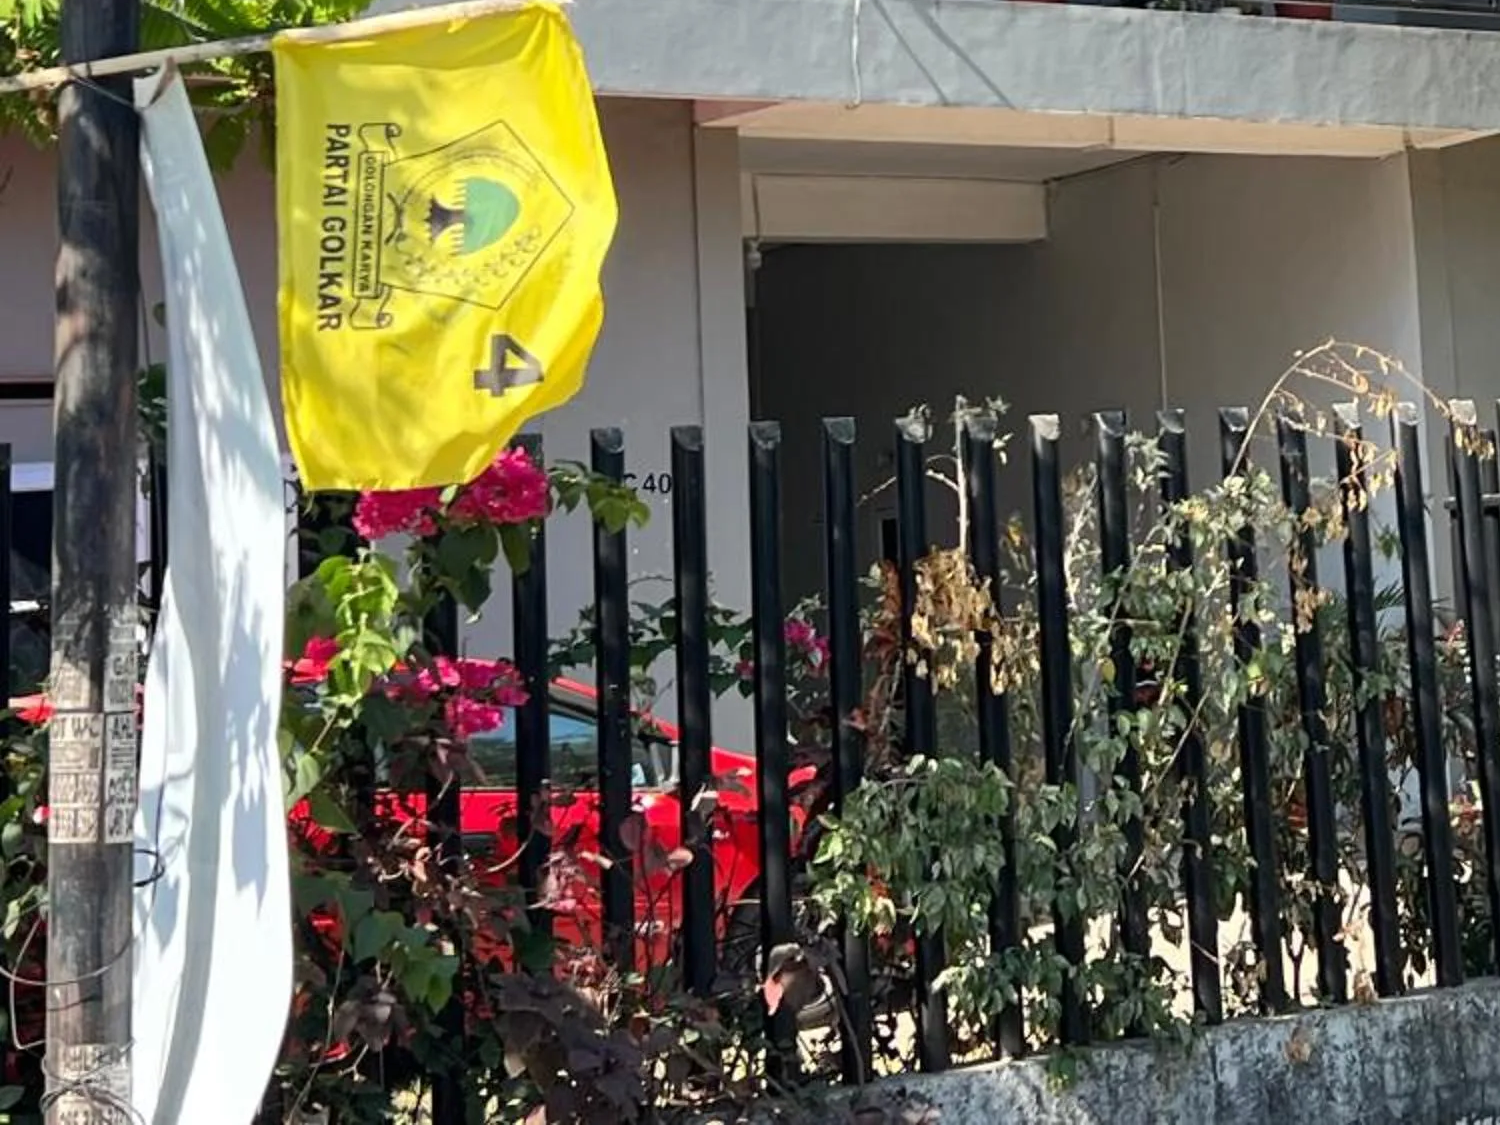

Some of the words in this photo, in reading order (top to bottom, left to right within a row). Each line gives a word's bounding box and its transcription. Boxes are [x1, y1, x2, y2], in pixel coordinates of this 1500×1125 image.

[321, 123, 351, 207] PARTAI
[361, 156, 376, 235] GOLONGAN
[317, 216, 347, 332] GOLKAR
[358, 240, 373, 293] KARYA
[473, 334, 545, 397] 4
